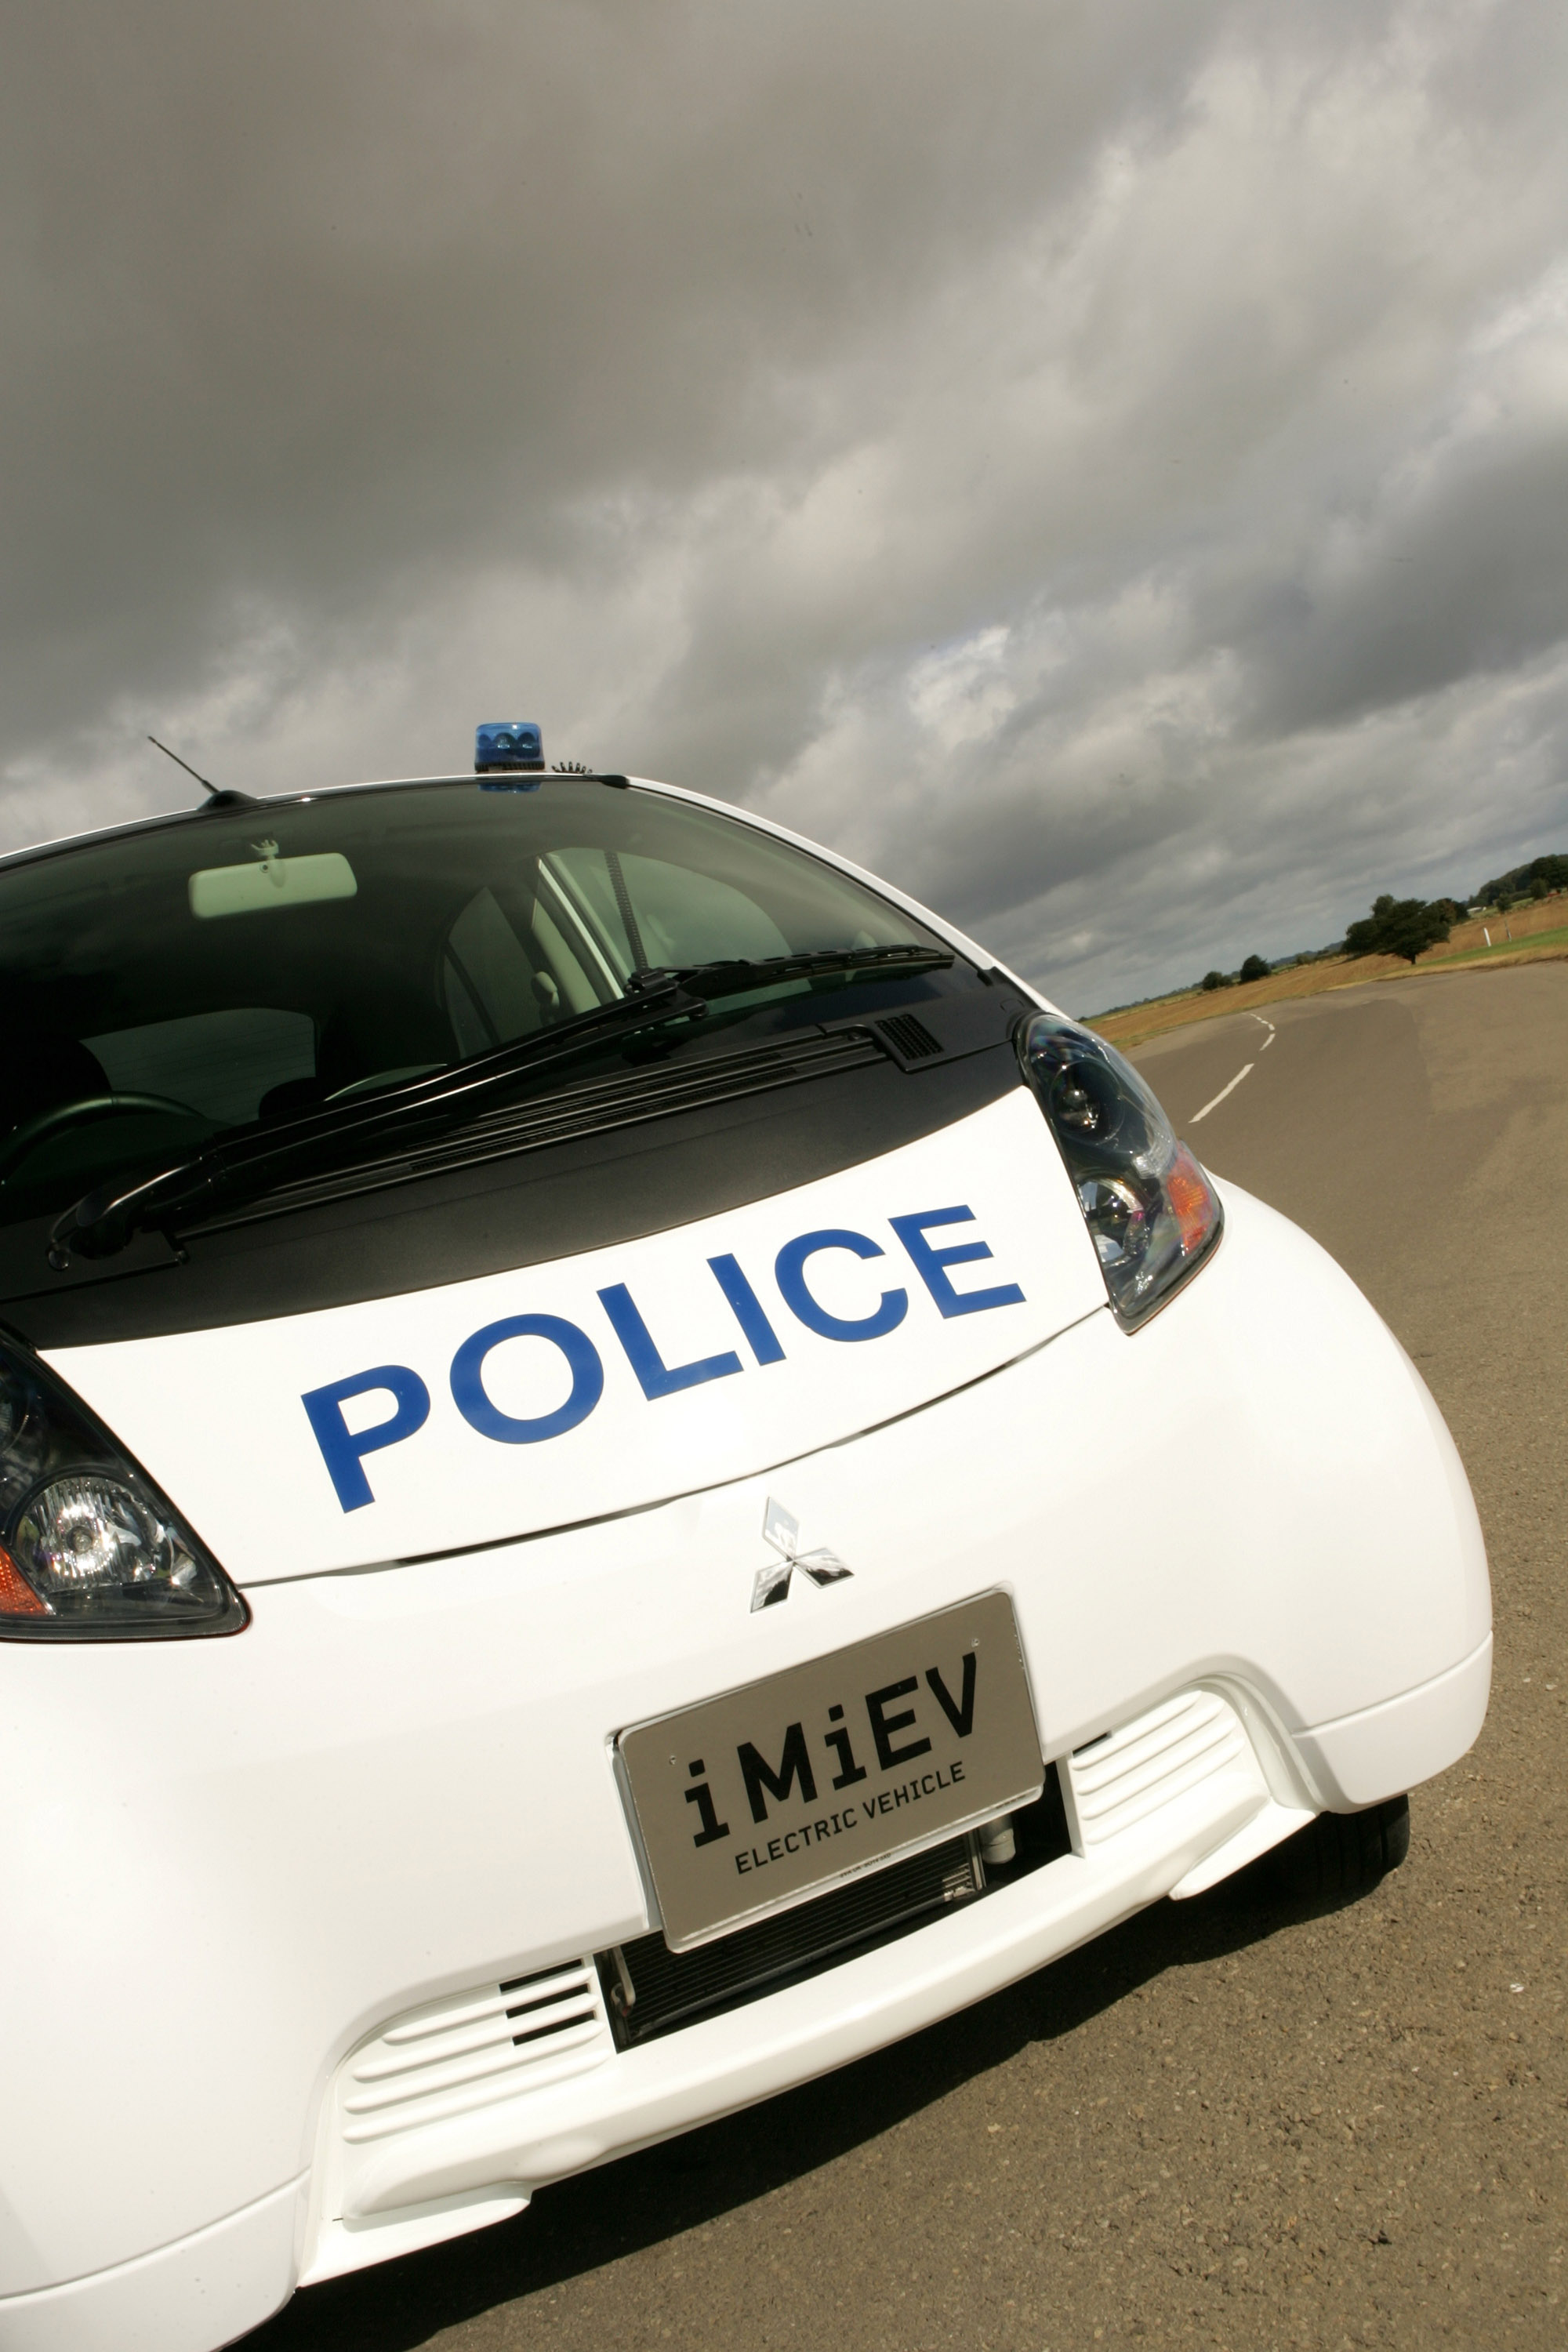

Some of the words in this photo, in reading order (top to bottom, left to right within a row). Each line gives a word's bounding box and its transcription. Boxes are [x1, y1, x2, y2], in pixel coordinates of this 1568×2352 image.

[301, 1205, 1026, 1514] POLICE
[735, 1807, 858, 1876] ELECTRIC
[862, 1761, 966, 1819] VEHICLE
